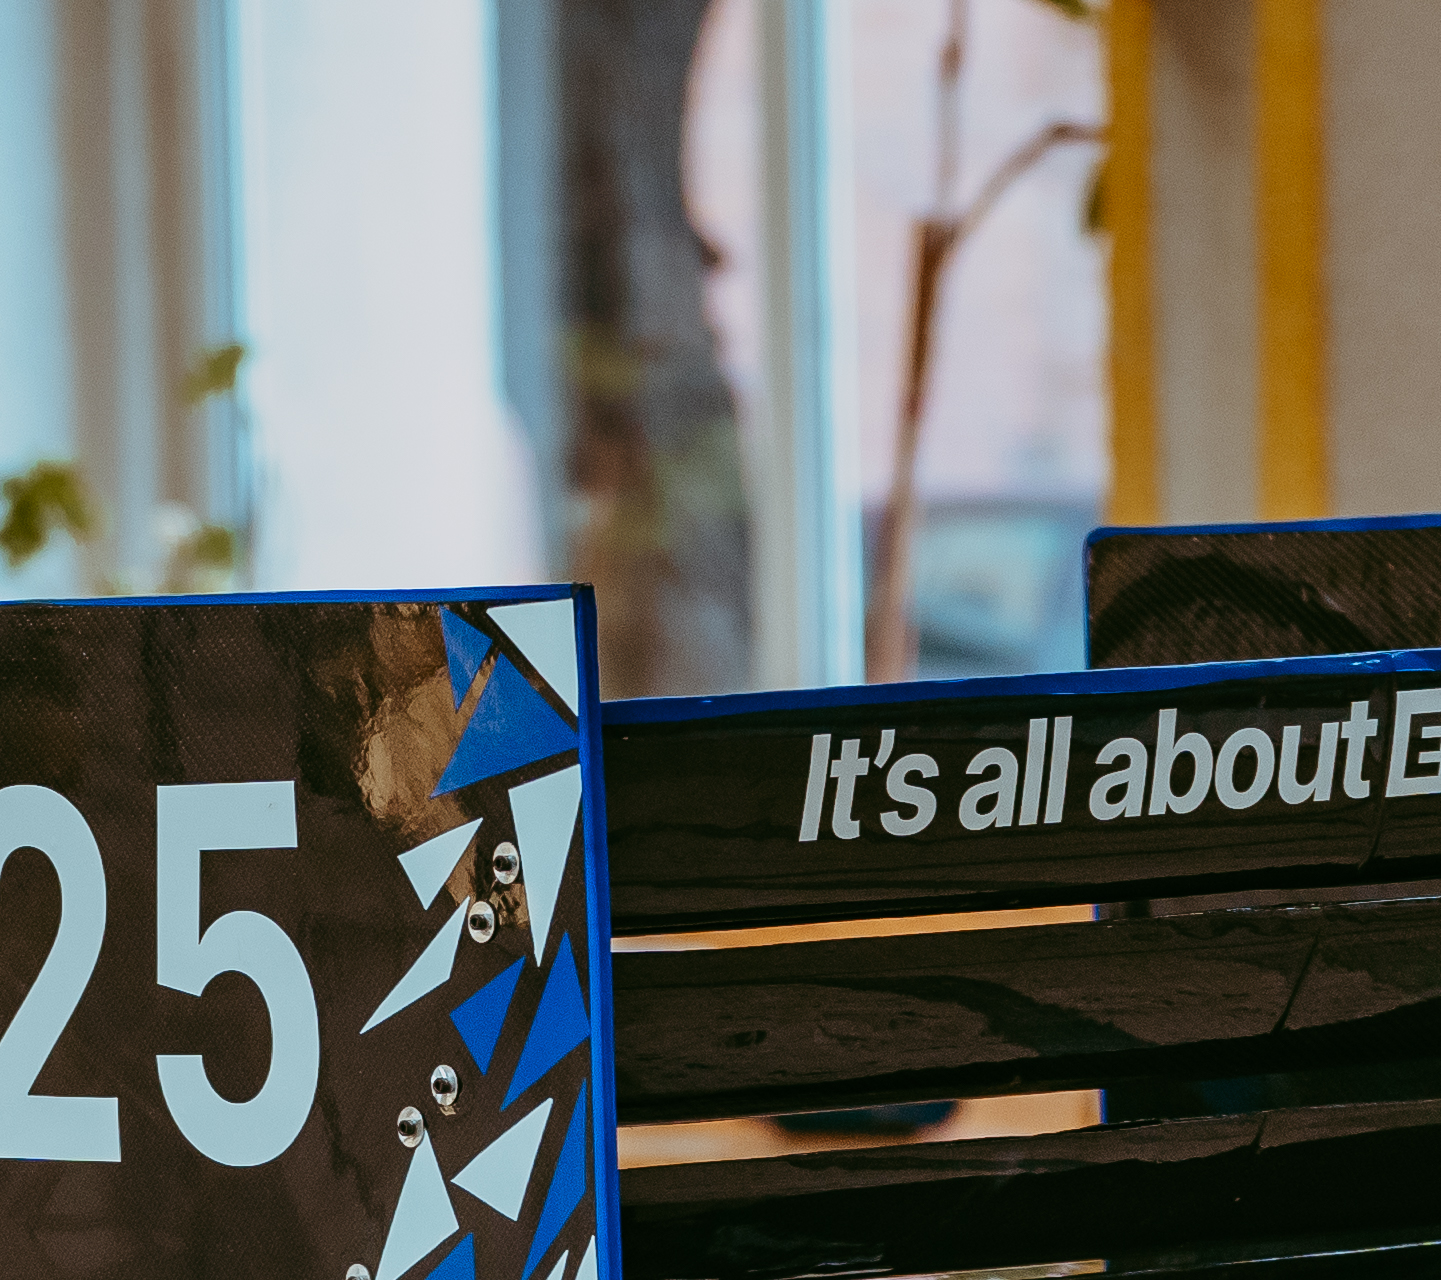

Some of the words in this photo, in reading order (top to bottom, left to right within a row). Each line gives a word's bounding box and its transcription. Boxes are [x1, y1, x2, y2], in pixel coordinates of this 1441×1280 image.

[798, 727, 939, 845] It's
[960, 715, 1071, 831] all
[1089, 702, 1379, 823] about
